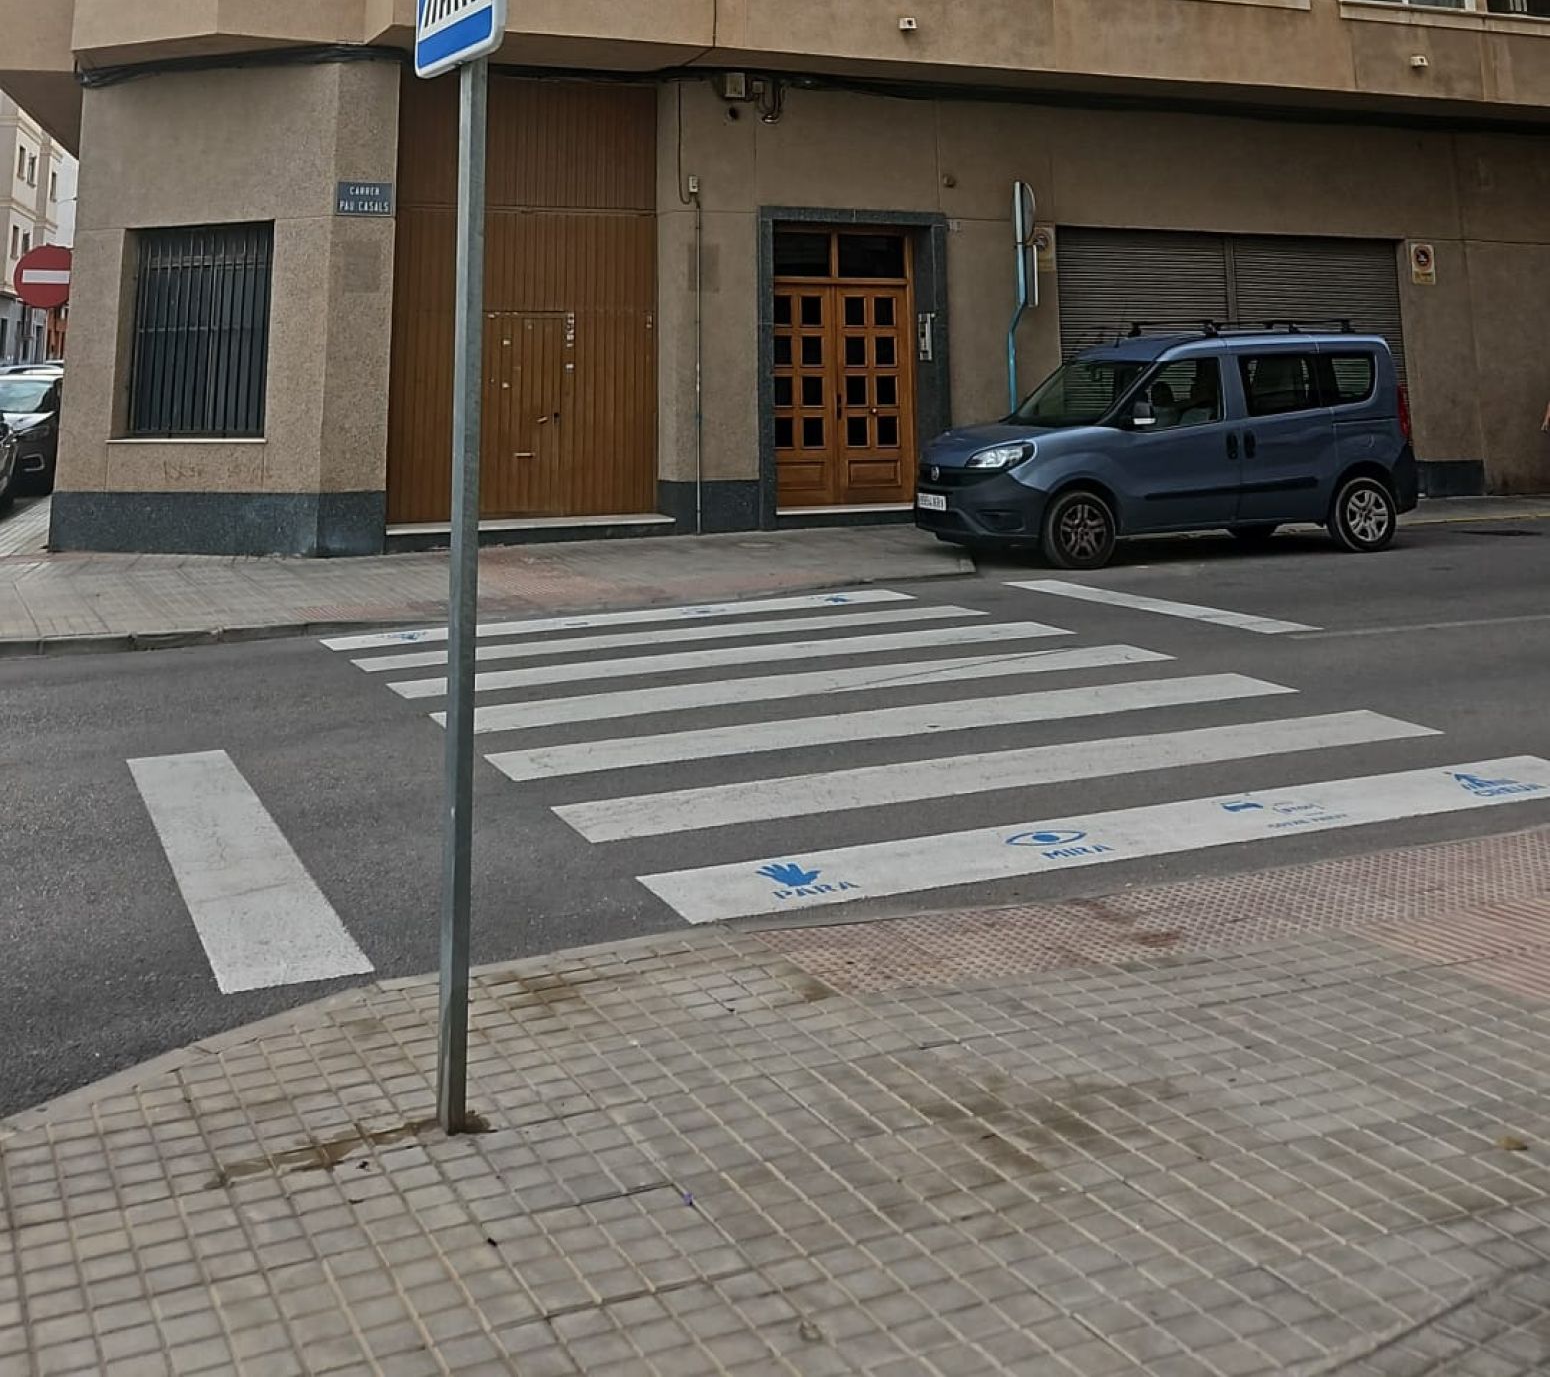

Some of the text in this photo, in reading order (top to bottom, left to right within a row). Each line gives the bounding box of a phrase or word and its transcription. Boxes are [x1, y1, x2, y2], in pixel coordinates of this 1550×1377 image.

[349, 186, 380, 196] CARRER
[339, 200, 389, 213] PAU CASALS
[1041, 844, 1116, 860] MIRA
[772, 881, 862, 899] PARA
